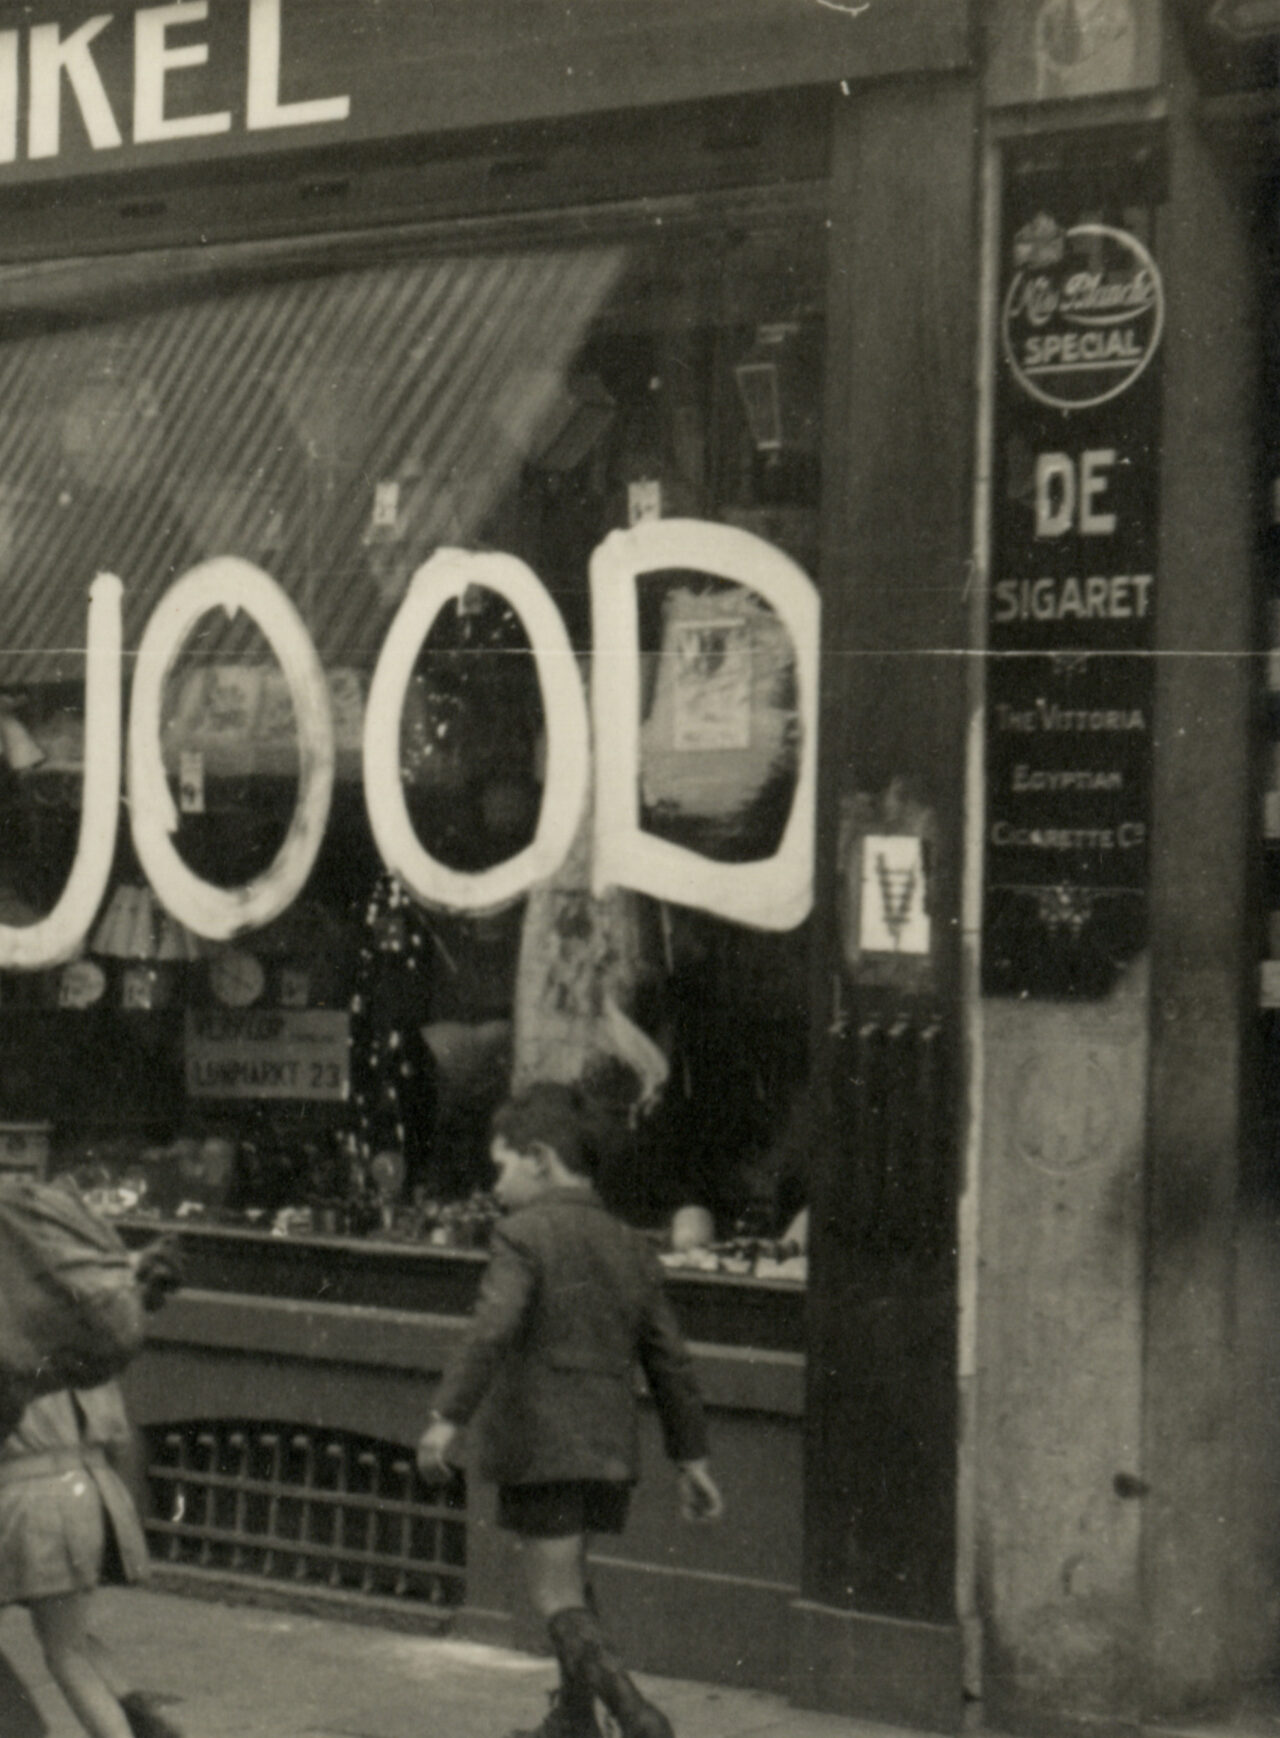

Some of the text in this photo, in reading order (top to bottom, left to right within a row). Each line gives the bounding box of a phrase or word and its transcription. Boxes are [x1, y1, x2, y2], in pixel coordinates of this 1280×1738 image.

[1025, 330, 1143, 366] SPECIAL
[1034, 449, 1118, 539] DE
[995, 574, 1153, 622] SIGARET
